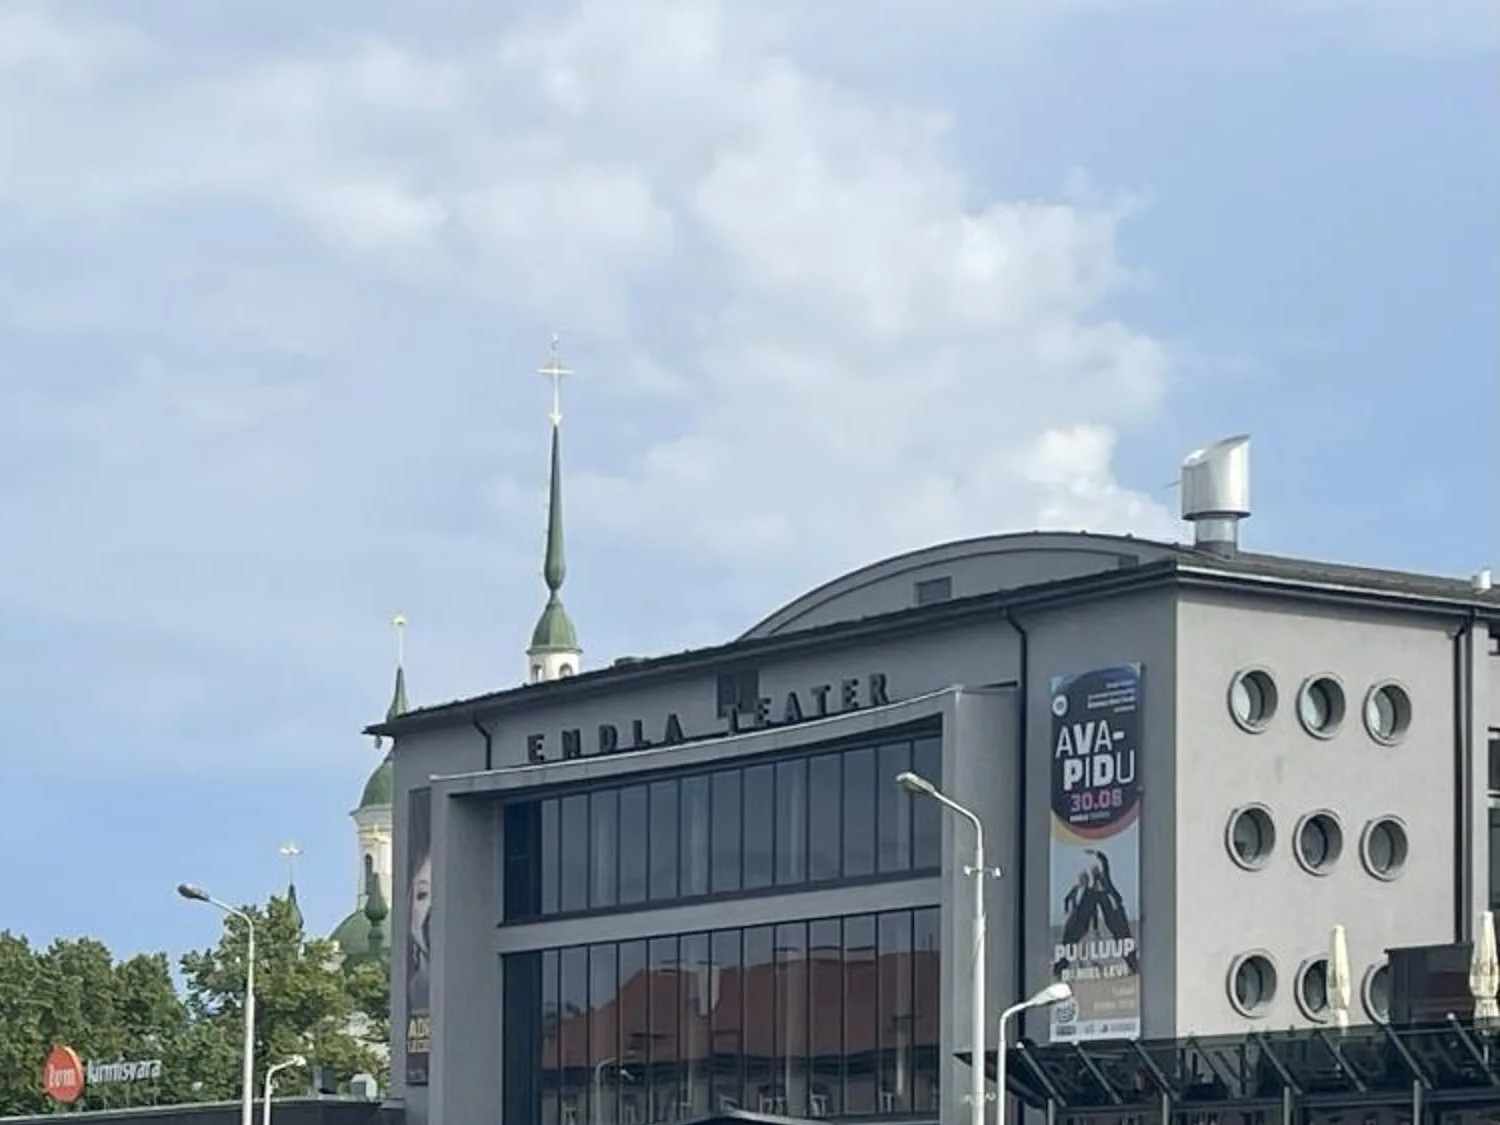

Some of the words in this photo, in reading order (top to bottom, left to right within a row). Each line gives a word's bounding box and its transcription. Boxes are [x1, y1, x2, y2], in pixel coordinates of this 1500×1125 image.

[526, 712, 687, 763] ENDLA
[726, 673, 890, 735] TEATER
[1055, 719, 1125, 759] AVA-
[1063, 749, 1135, 791] PIDU
[1069, 787, 1124, 813] 30.08
